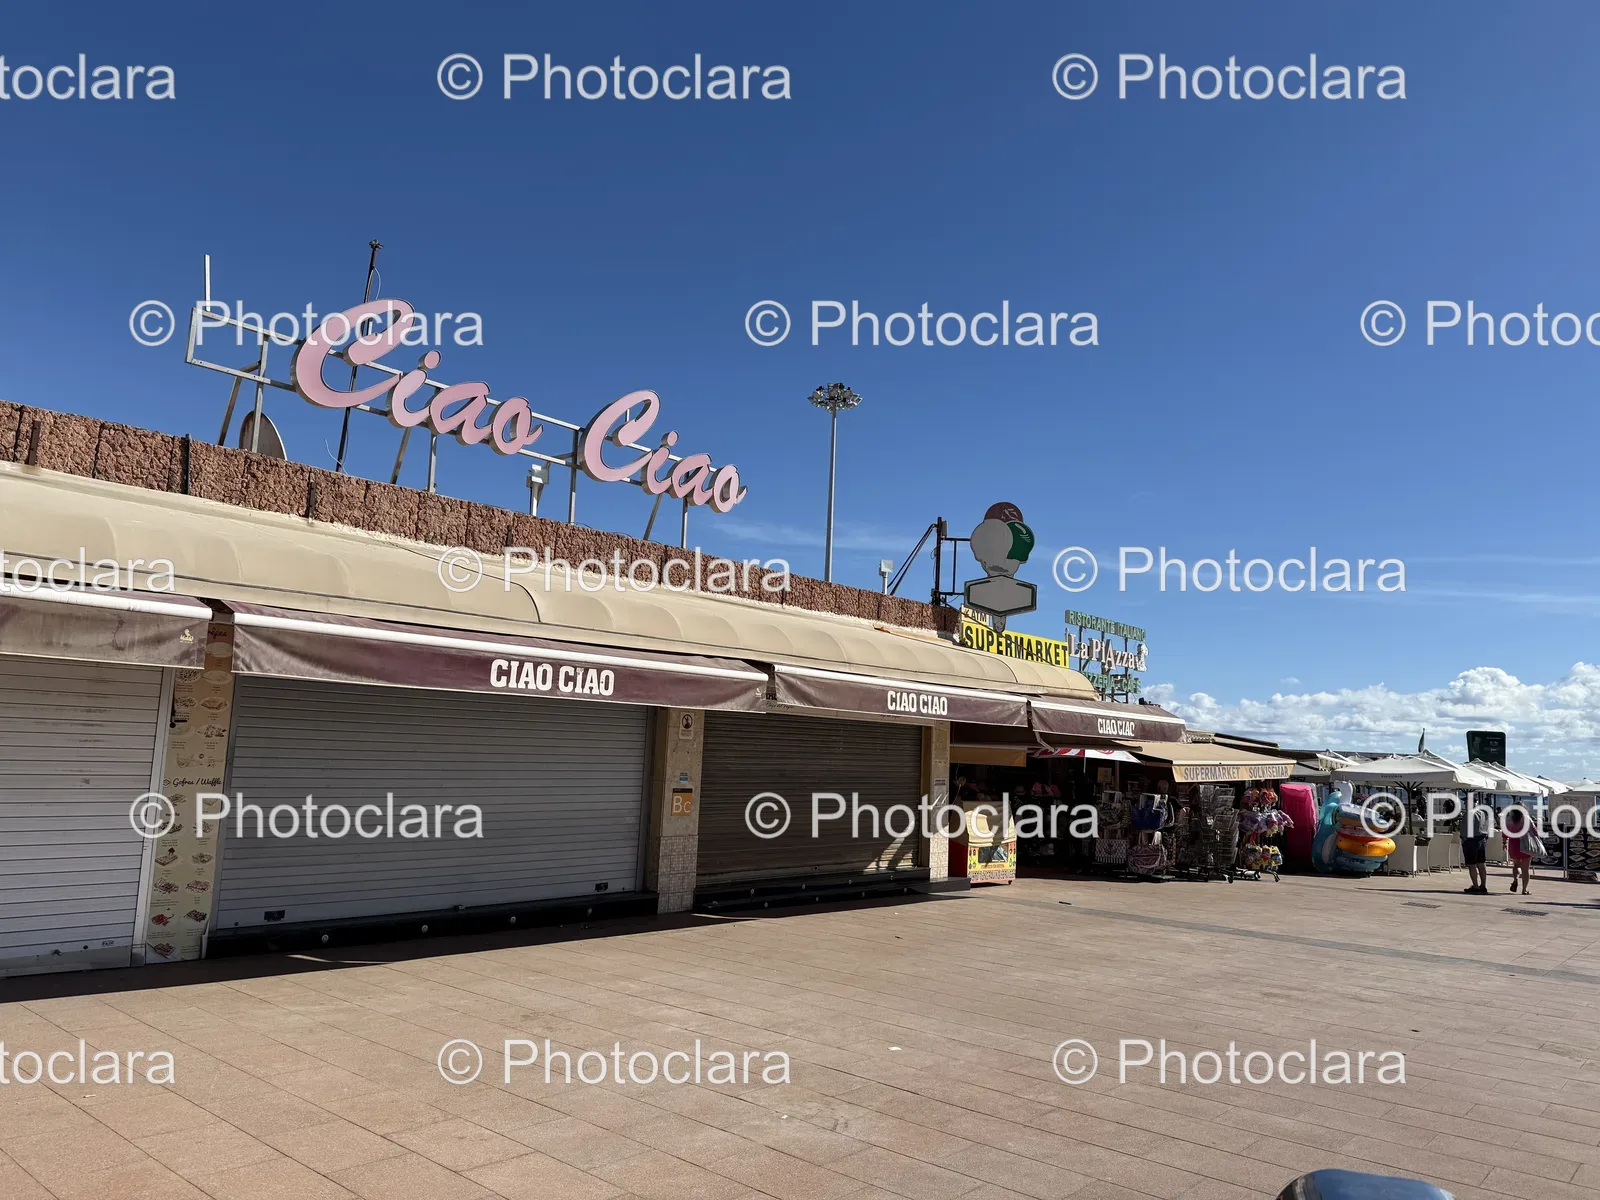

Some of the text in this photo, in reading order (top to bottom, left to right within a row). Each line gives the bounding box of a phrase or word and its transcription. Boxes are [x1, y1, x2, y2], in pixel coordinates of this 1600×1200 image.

[290, 297, 748, 513] Ciao Ciao
[1069, 611, 1146, 642] RISTORANTE ITALIANO
[964, 624, 1068, 667] SUPERMARKET
[1069, 633, 1089, 660] La
[489, 658, 615, 697] CIAO CIAO
[887, 690, 948, 716] CIAO CIAO
[1097, 718, 1118, 735] CIAO
[1183, 767, 1241, 781] SUPERMARKET
[672, 796, 692, 814] Bc
